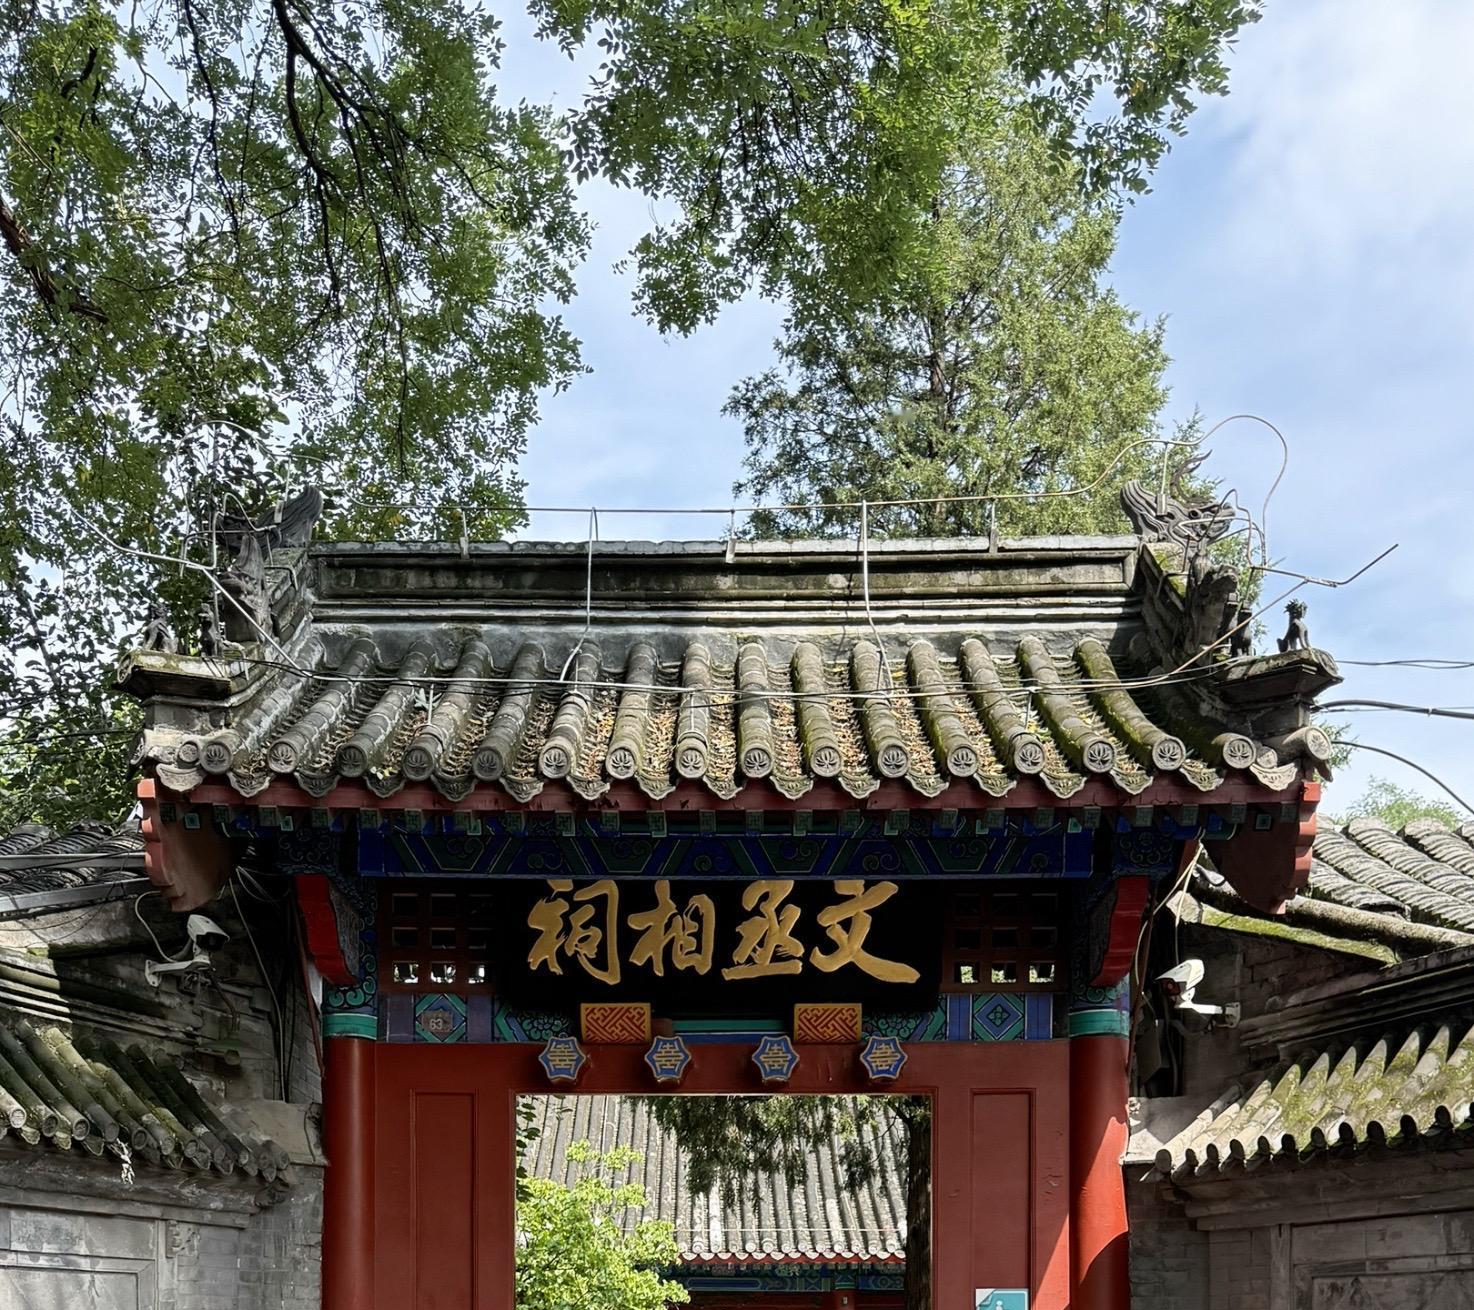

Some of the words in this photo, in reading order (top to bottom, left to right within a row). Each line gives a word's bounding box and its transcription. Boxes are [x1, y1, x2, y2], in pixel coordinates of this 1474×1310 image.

[527, 879, 921, 986] 文丞相祠
[429, 1017, 444, 1031] 63
